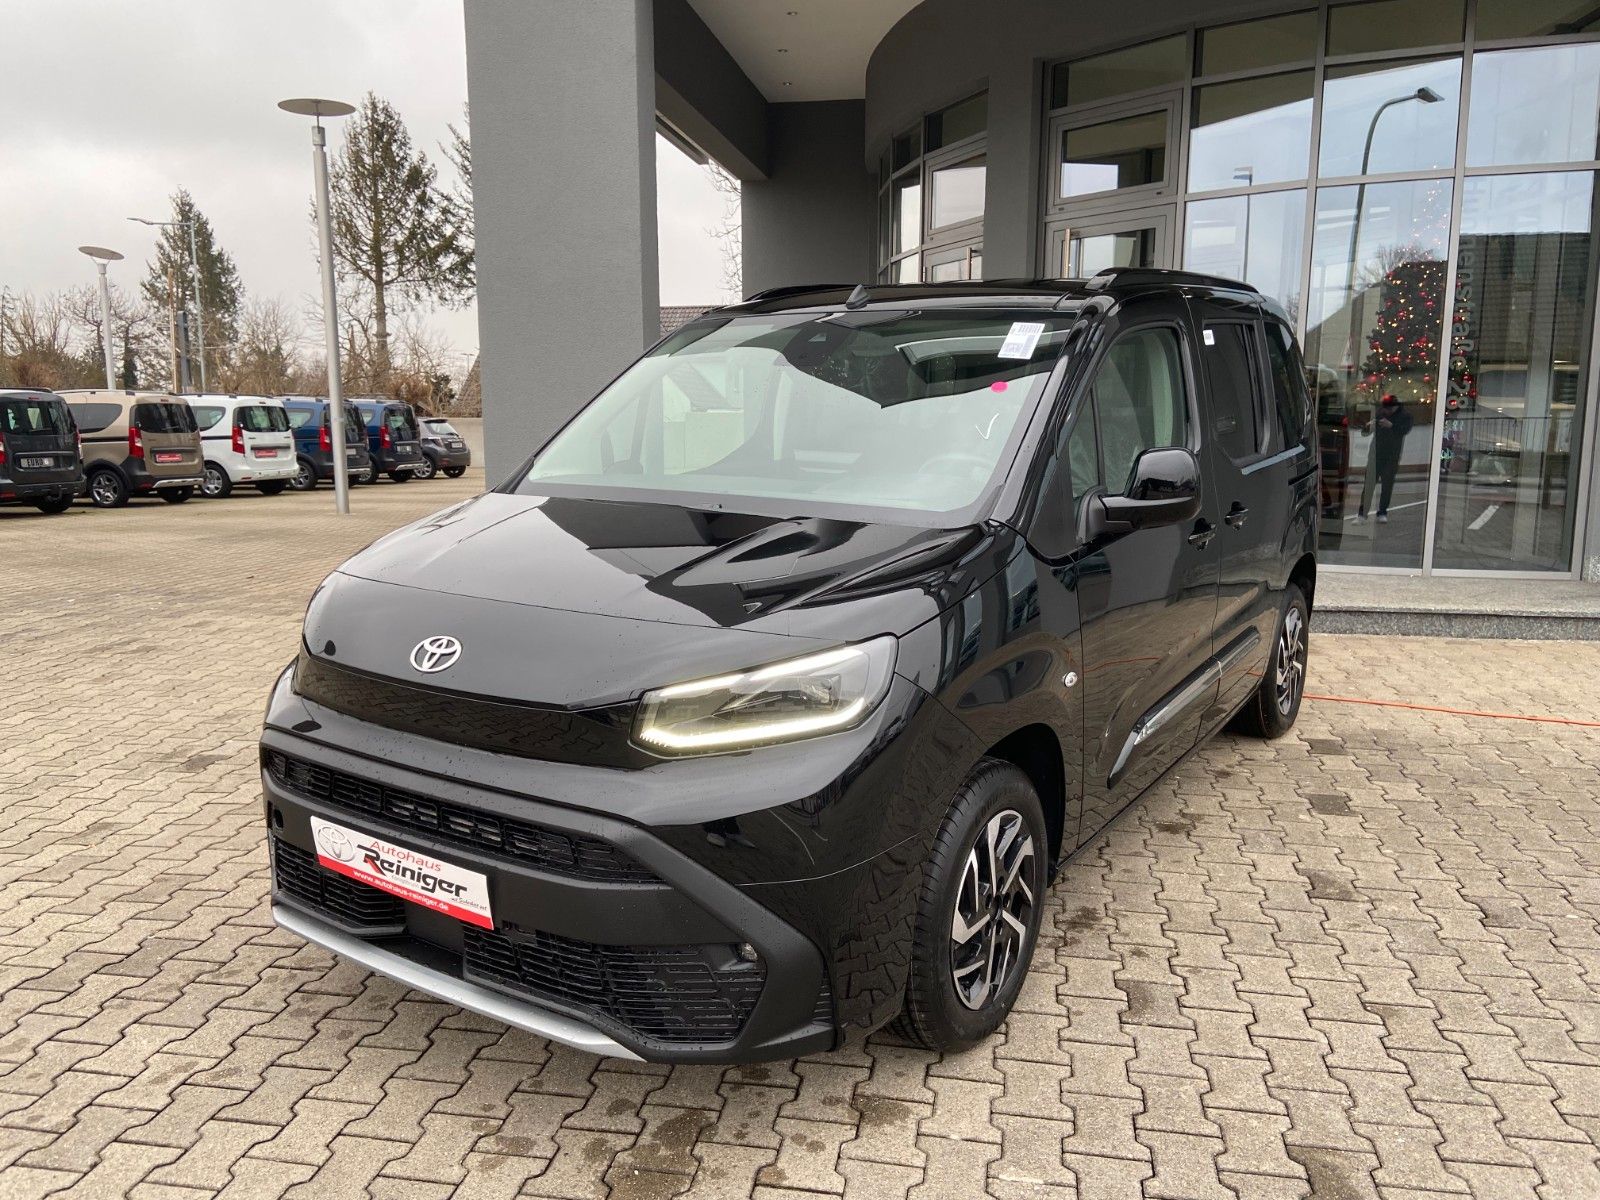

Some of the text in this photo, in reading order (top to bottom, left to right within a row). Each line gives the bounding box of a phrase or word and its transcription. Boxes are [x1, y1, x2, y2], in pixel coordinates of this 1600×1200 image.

[1446, 380, 1470, 410] 28
[357, 844, 467, 897] Reiniger
[370, 841, 441, 872] Autohaus
[353, 870, 449, 911] www.autohaus-reiniger.de
